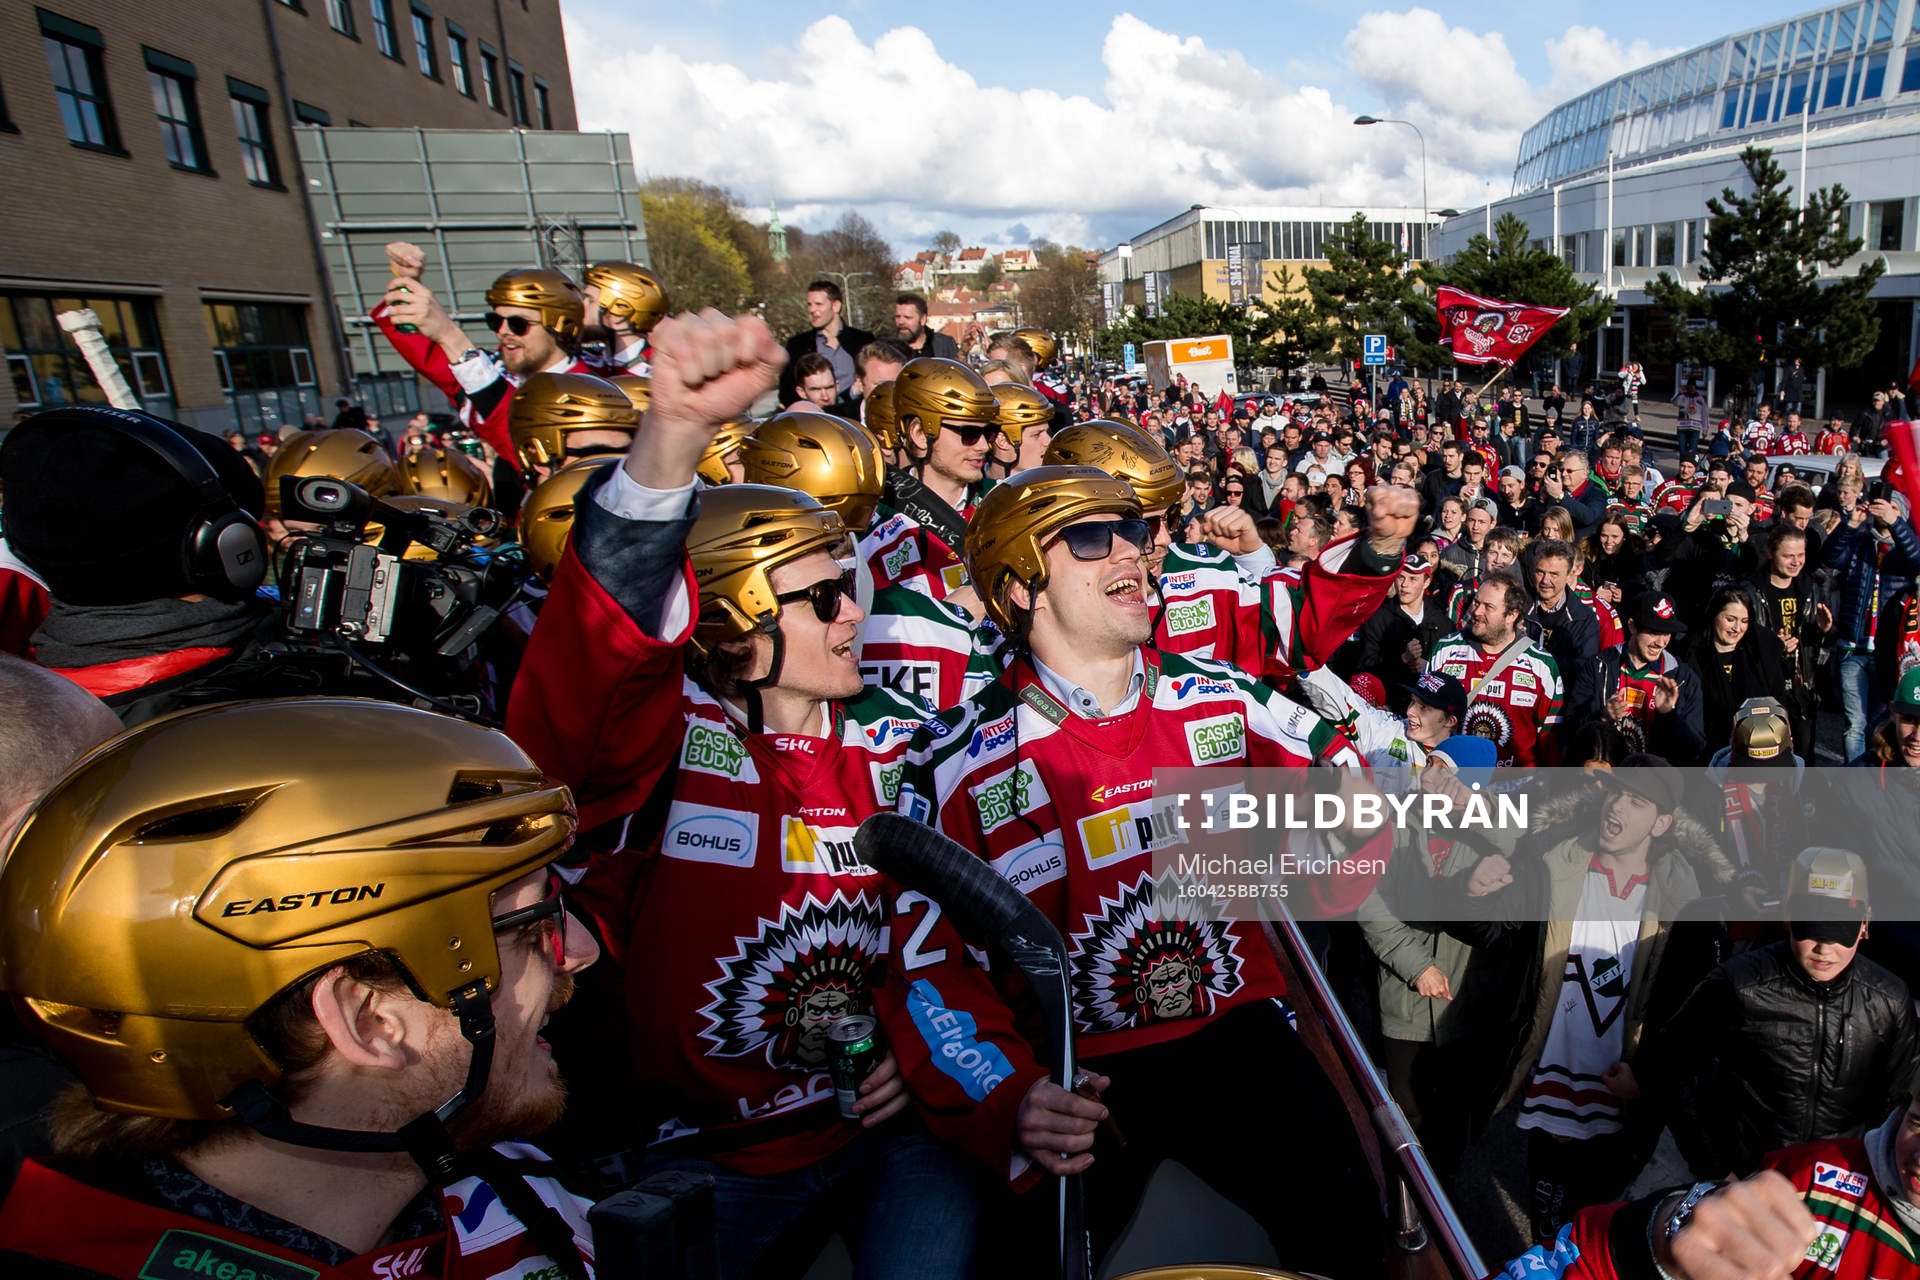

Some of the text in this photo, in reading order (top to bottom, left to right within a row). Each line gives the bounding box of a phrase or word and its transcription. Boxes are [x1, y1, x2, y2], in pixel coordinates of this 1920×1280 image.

[1228, 244, 1242, 286] SM-FINAL
[1371, 337, 1381, 353] P
[761, 459, 794, 470] EASTON
[1168, 573, 1196, 583] INTER
[1170, 580, 1196, 591] SPORT
[1168, 607, 1199, 621] CASH
[1170, 613, 1210, 632] BUDDY
[982, 717, 1014, 740] INTER
[1195, 723, 1236, 744] CASH
[775, 738, 815, 754] SHL
[1198, 738, 1241, 760] BUDD
[1105, 778, 1158, 799] EASTON
[676, 831, 742, 852] BOHUS
[222, 883, 385, 918] EASTON
[896, 890, 947, 971] 2
[1834, 1180, 1863, 1195] SPORT
[1838, 1172, 1864, 1185] INTER
